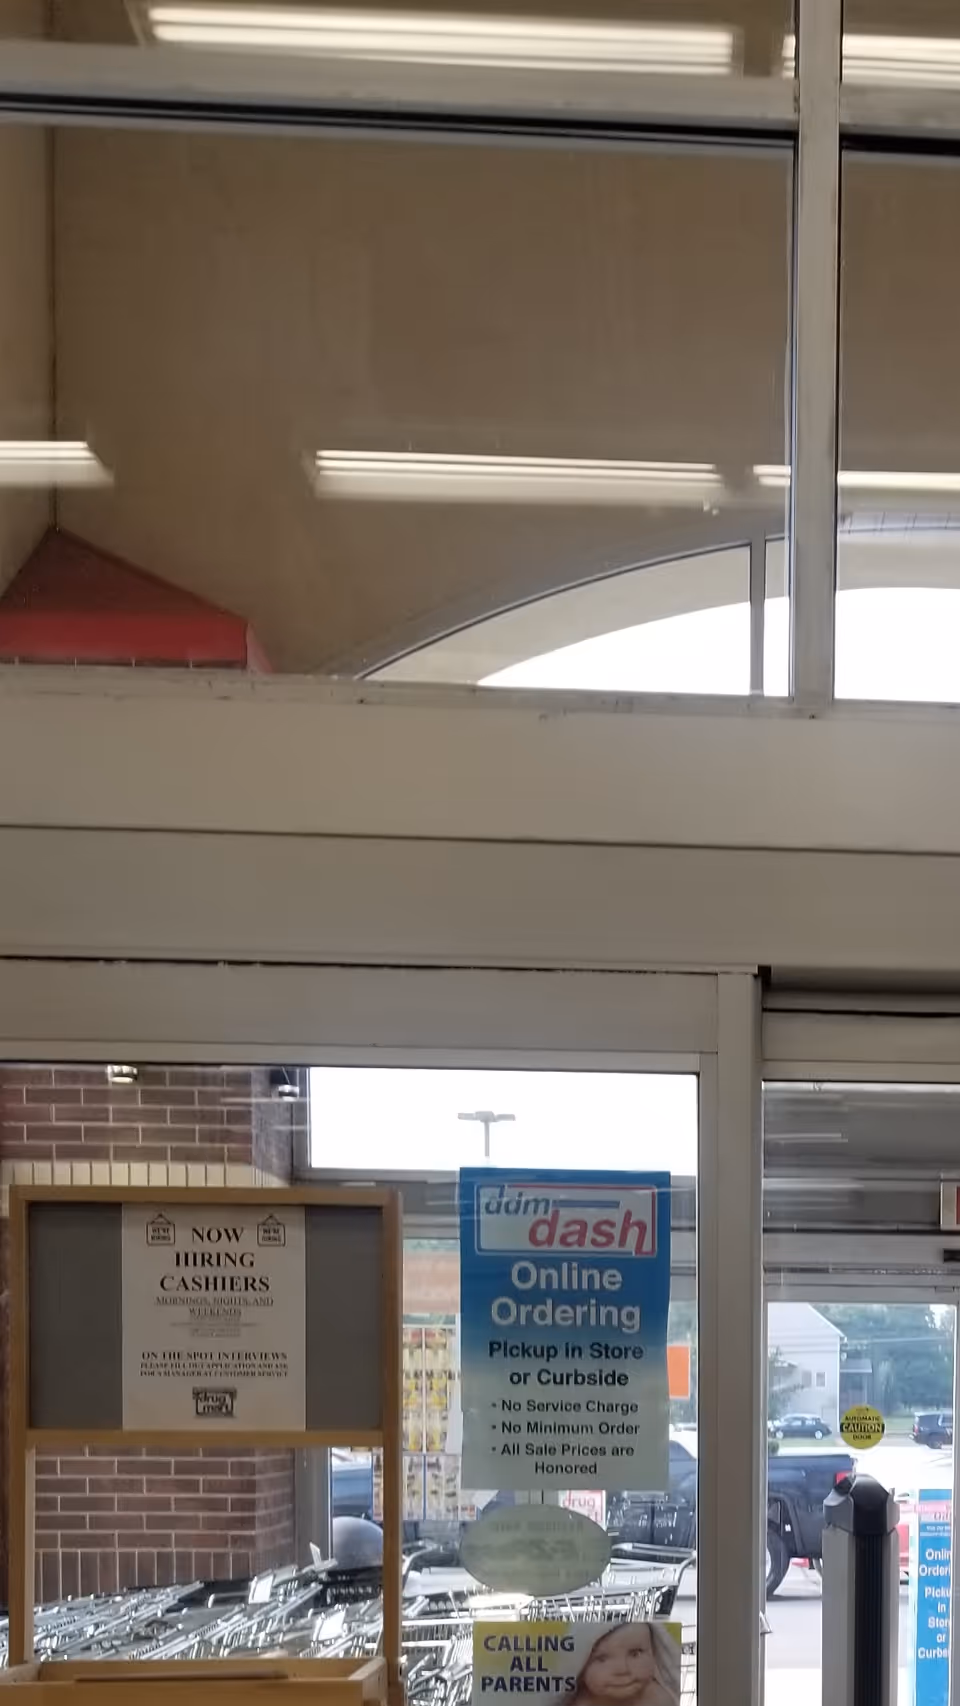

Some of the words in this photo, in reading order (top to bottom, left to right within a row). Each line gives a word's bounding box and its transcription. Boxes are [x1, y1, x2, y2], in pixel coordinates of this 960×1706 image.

[484, 1184, 550, 1215] ddm
[191, 1226, 245, 1243] NOW
[528, 1208, 648, 1250] dash
[174, 1251, 256, 1268] HIRING
[159, 1275, 271, 1292] CASHIERS
[511, 1260, 623, 1291] Online
[491, 1296, 641, 1334] Ordering
[141, 1351, 158, 1361] ON
[186, 1351, 213, 1361] SPOT
[488, 1340, 559, 1362] Pickup
[564, 1341, 582, 1359] in
[588, 1341, 644, 1360] Store
[509, 1371, 530, 1386] or
[536, 1368, 629, 1387] Curbside
[501, 1399, 522, 1413] No
[526, 1399, 581, 1413] Service
[585, 1399, 639, 1416] Charge
[501, 1421, 522, 1434] No
[526, 1421, 594, 1435] Minimum
[598, 1421, 641, 1435] Order
[843, 1423, 881, 1432] CAUTION
[501, 1443, 520, 1456] All
[525, 1443, 557, 1456] Sale
[561, 1443, 607, 1456] Prices
[611, 1446, 635, 1456] are
[534, 1461, 598, 1475] Honored
[483, 1634, 575, 1652] CALLING
[510, 1655, 549, 1672] ALL
[481, 1676, 576, 1693] PARENTS
